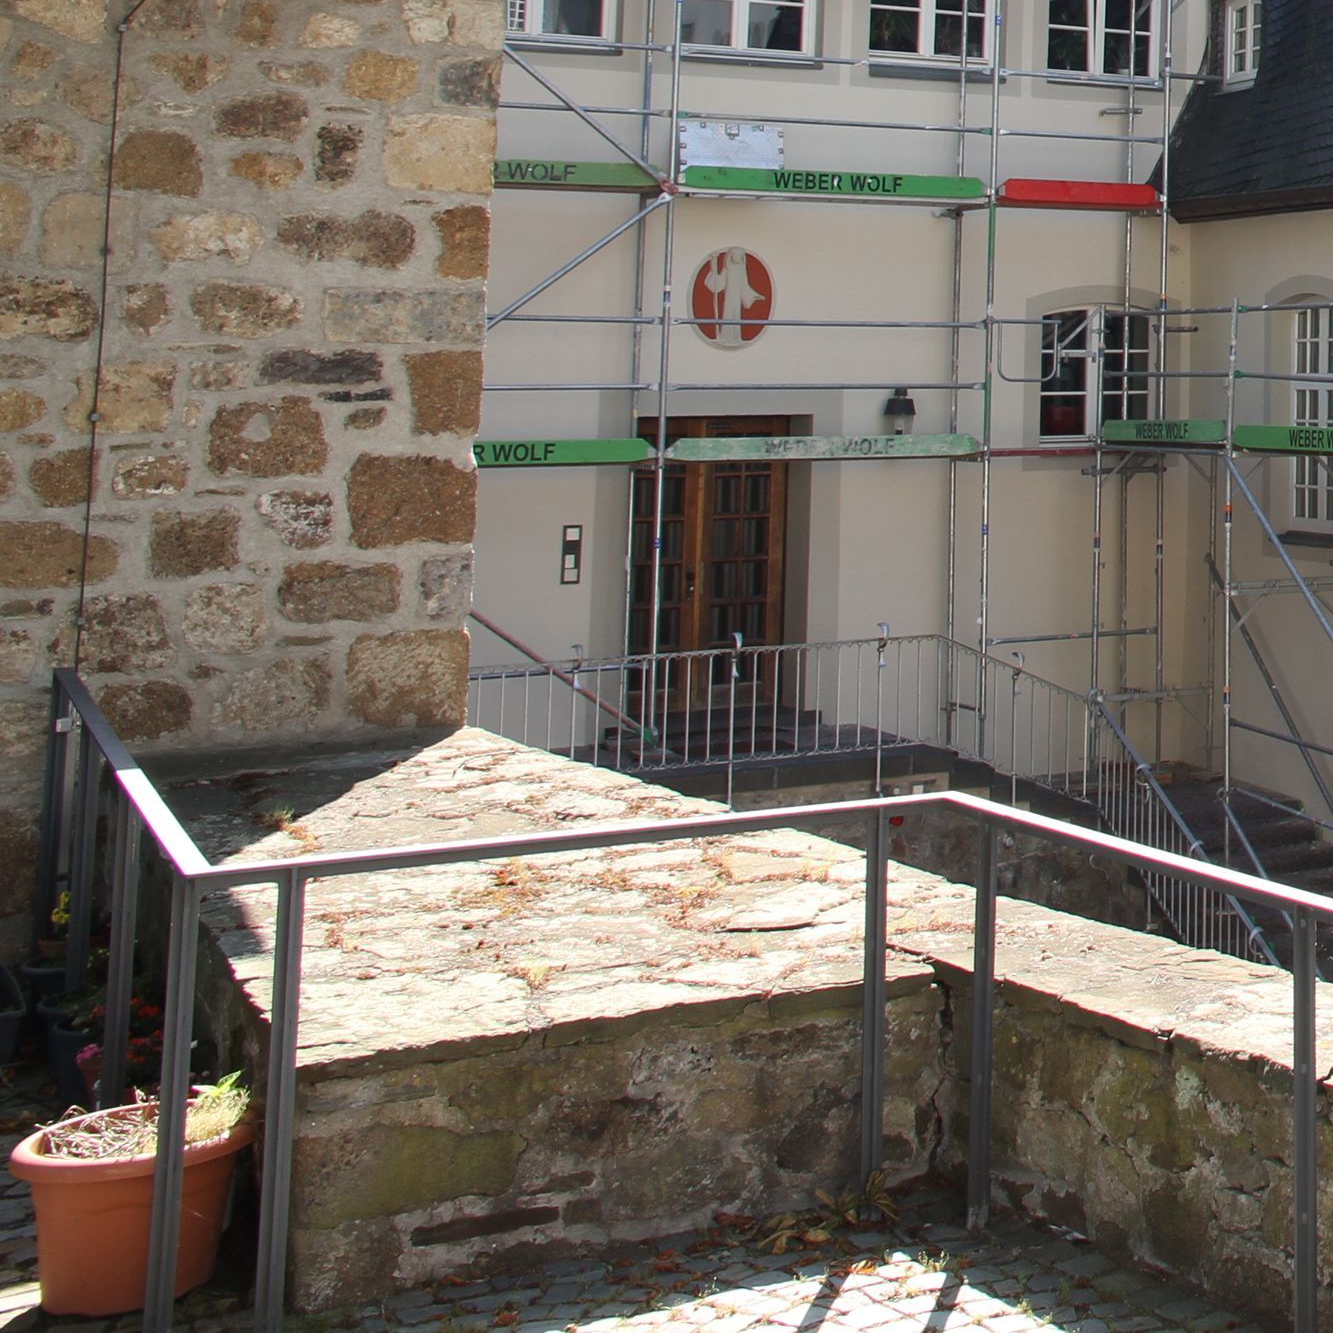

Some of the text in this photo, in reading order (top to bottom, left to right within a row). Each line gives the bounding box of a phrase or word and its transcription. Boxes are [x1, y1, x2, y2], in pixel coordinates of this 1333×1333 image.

[508, 162, 577, 182] WOLF
[774, 172, 903, 193] WEBER WOLF
[1135, 422, 1189, 439] WEBER WOLF
[1289, 429, 1325, 448] WEBER
[492, 443, 556, 462] WOLF
